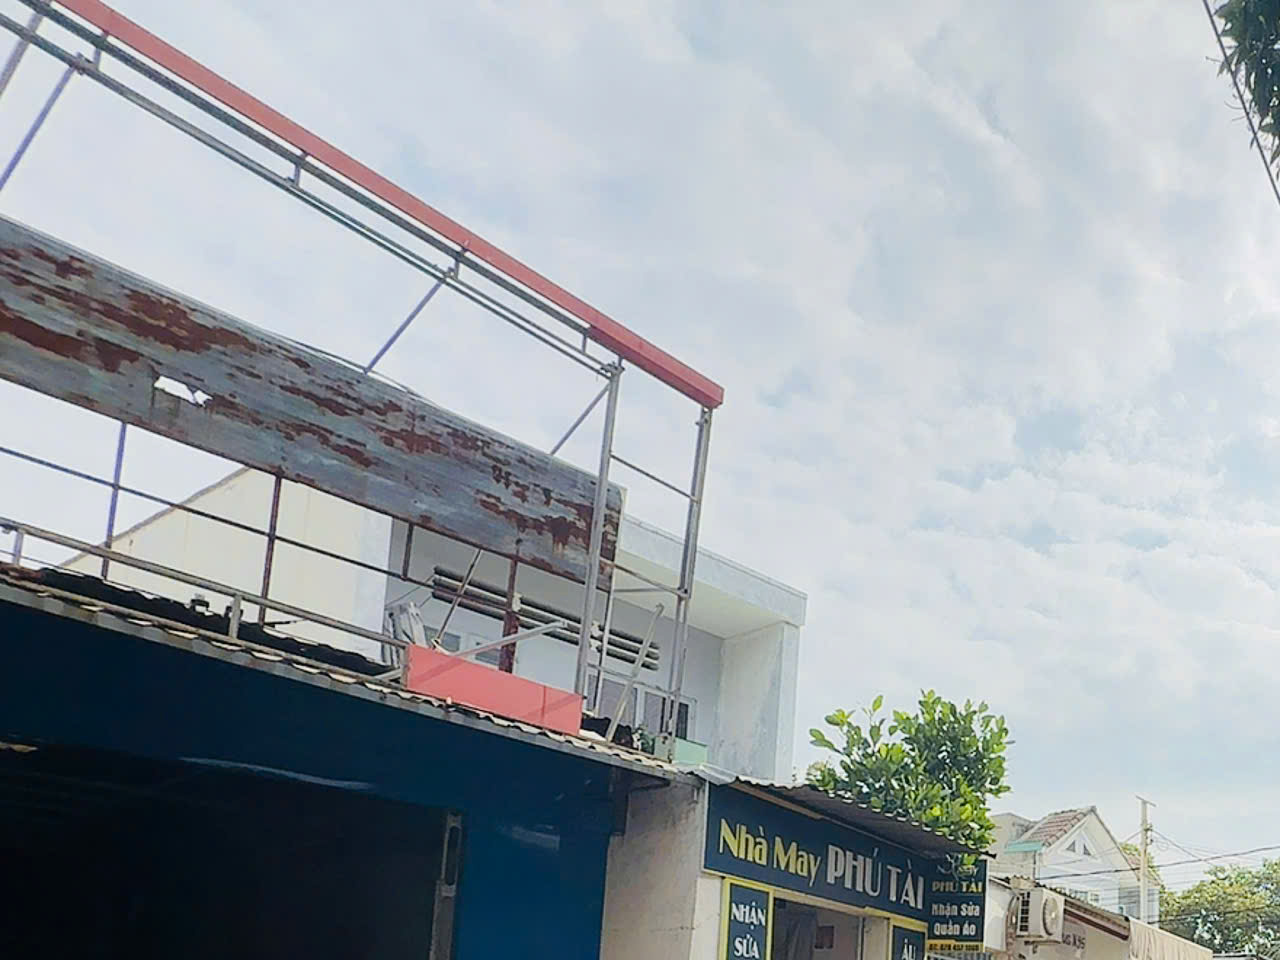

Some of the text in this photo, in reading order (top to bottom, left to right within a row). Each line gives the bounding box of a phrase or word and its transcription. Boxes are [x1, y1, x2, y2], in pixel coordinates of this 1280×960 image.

[719, 818, 768, 867] Nhà
[773, 836, 822, 887] May
[826, 845, 882, 898] PHÚ
[887, 858, 925, 910] TÀI
[730, 901, 767, 930] NHẬN
[733, 933, 760, 959] SỬA
